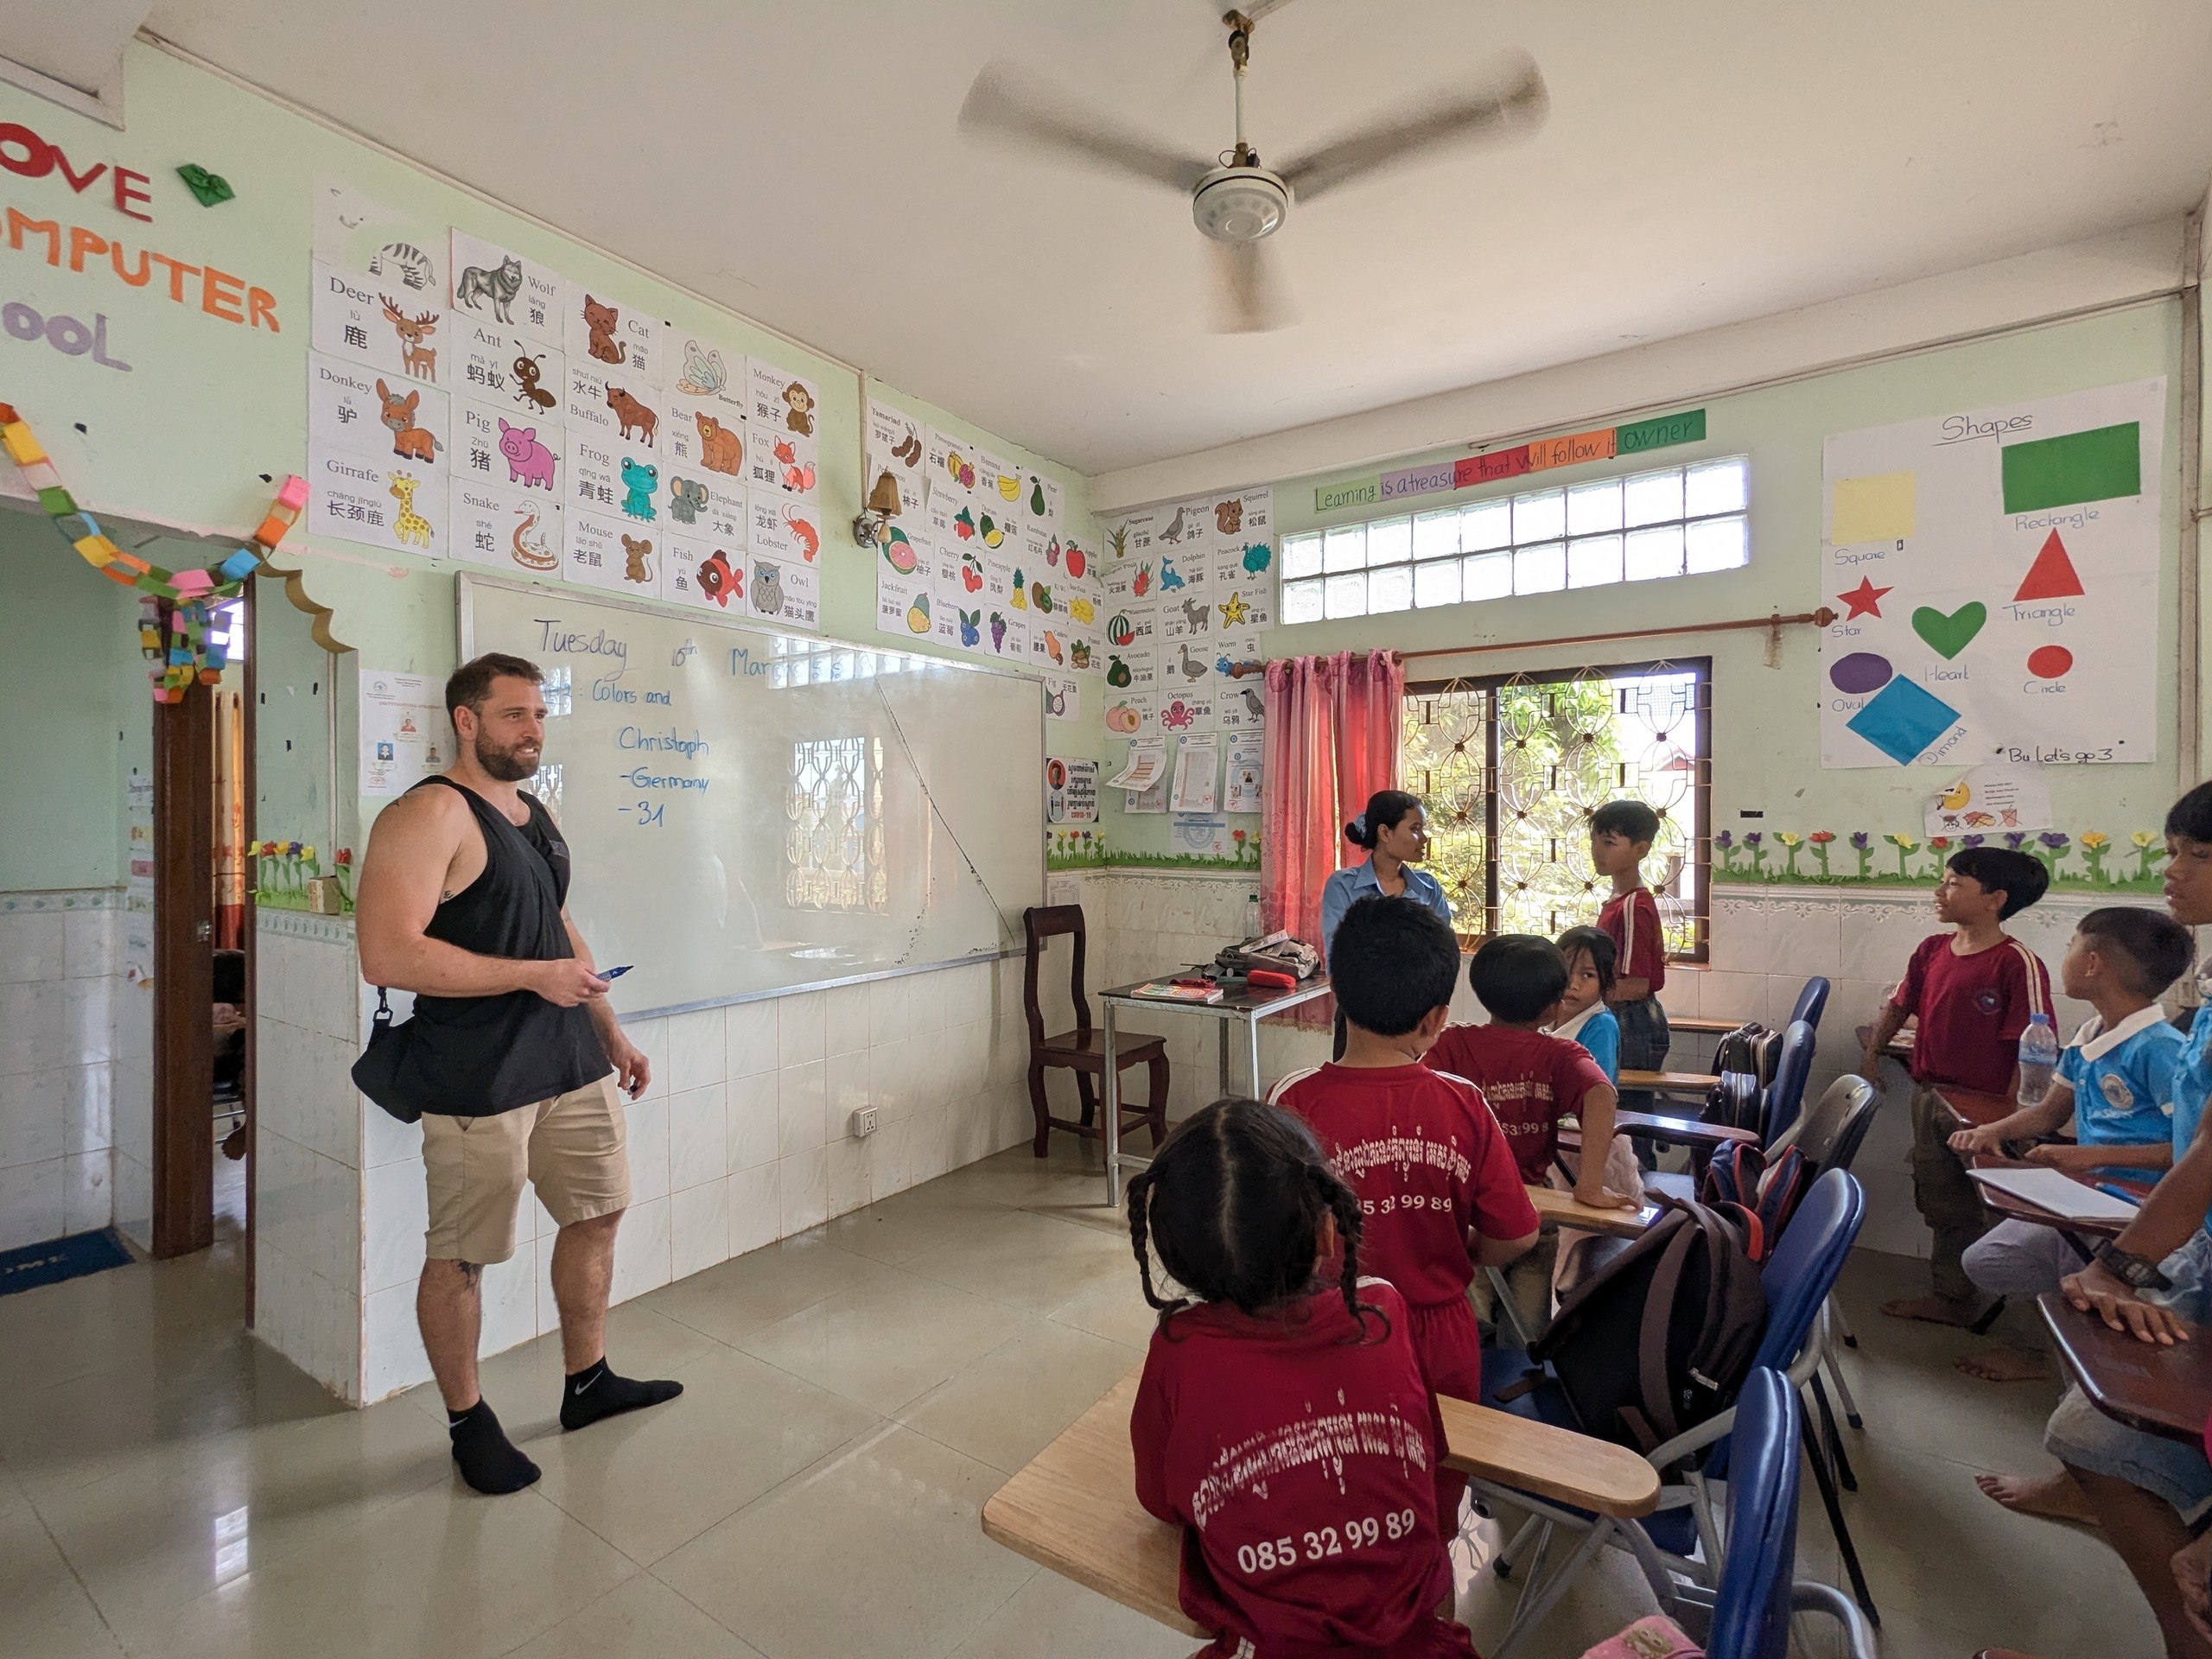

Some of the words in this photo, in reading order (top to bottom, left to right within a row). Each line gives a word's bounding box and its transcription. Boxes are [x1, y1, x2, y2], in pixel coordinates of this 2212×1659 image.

[0, 207, 281, 334] MPUTER
[330, 276, 374, 306] Deer
[528, 276, 556, 296] Wolf
[530, 308, 545, 327] 狼
[344, 324, 368, 350] 鹿
[474, 327, 501, 348] Ant
[628, 320, 649, 339] Cat
[632, 353, 646, 372] 猫
[320, 367, 372, 395] Donkey
[467, 363, 505, 392] 蚂蚁
[753, 368, 785, 390] Monkey
[572, 380, 602, 400] 水牛
[718, 393, 743, 410] Butterfly
[338, 405, 358, 424] 驴
[569, 404, 609, 427] Buffalo
[671, 407, 693, 423] Bear
[757, 402, 781, 422] 猴子
[872, 406, 900, 426] Tamarind
[466, 410, 491, 434] Pig
[1941, 415, 2033, 443] Shapes
[752, 432, 770, 448] Fox
[579, 443, 610, 467] Frog
[674, 441, 688, 459] 熊
[471, 448, 492, 472] 猪
[981, 456, 1001, 471] Banana
[1314, 484, 1376, 512] Learning
[1379, 480, 1394, 496] is
[1478, 454, 1510, 478] that
[1552, 440, 1599, 466] follow
[1624, 420, 1693, 450] owner
[327, 459, 379, 483] Girrafe
[753, 465, 776, 484] 狐狸
[578, 480, 614, 505] 青蛙
[710, 491, 743, 509] Elephant
[1243, 491, 1268, 503] Squirrel
[463, 493, 500, 512] Snake
[1185, 505, 1210, 517] Pigeon
[327, 500, 385, 527] 长颈鹿
[755, 515, 779, 531] 龙虾
[1249, 515, 1267, 527] 松鼠
[2014, 506, 2101, 532] Rectangle
[578, 521, 613, 539] Mouse
[712, 520, 735, 537] 大象
[475, 531, 495, 552] 蛇
[756, 534, 789, 551] Lobster
[1217, 546, 1241, 556] Peacock
[573, 549, 603, 568] 老鼠
[672, 547, 694, 562] Fish
[939, 546, 960, 562] Cherry
[1182, 552, 1205, 563] Dolphin
[1834, 548, 1885, 566] Square
[988, 558, 1011, 573] Pineapple
[675, 575, 689, 591] 鱼
[790, 574, 809, 588] Owl
[1218, 569, 1236, 582] 孔雀
[881, 580, 908, 595] Jackfruit
[784, 604, 816, 623] 猫头鹰
[937, 599, 961, 612] Blueberry
[1163, 605, 1180, 614] Goat
[2001, 604, 2075, 626] Triangle
[1007, 619, 1026, 630] Grapes
[1135, 625, 1153, 636] 西瓜
[1166, 626, 1184, 637] 山羊
[1832, 625, 1862, 639] Star
[533, 619, 634, 682] Tuesday
[1126, 652, 1150, 660] Avocado
[1247, 643, 1255, 653] 虫
[1048, 677, 1057, 689] Fig
[1923, 664, 1970, 683] Heart
[593, 679, 638, 703] Colors
[645, 690, 672, 706] and
[2023, 681, 2067, 695] Circle
[1832, 697, 1865, 713] Oval
[619, 727, 709, 761] Christoph
[1918, 725, 1967, 766] Dimond
[2036, 746, 2071, 762] Let's
[2098, 748, 2113, 761] 3
[1401, 1194, 1425, 1209] 99
[1431, 1197, 1452, 1212] 89
[1237, 1536, 1296, 1573] 085
[1303, 1527, 1343, 1560] 32
[1345, 1517, 1379, 1549] 99
[1385, 1509, 1414, 1540] 89
